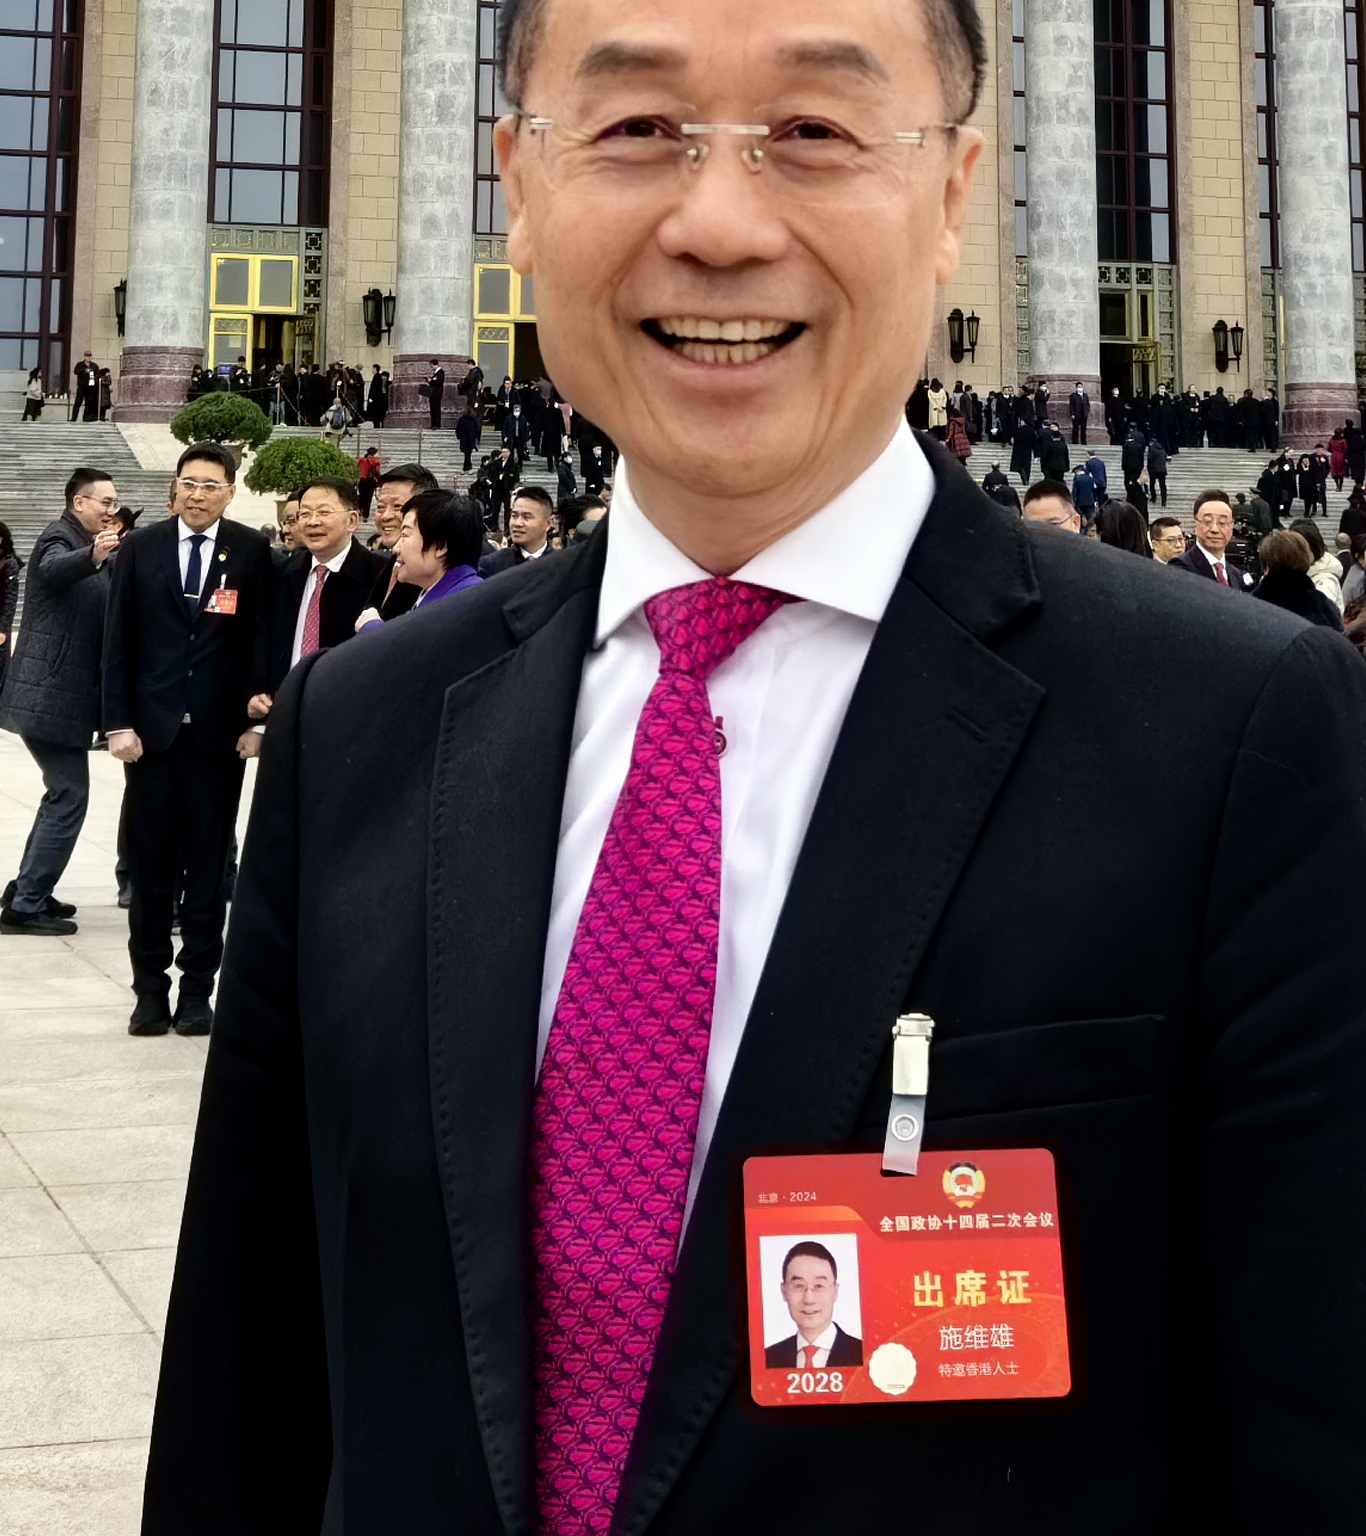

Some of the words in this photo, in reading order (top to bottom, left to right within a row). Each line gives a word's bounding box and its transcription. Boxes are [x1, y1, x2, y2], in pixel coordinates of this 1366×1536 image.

[790, 1191, 817, 1202] 2024
[880, 1212, 1054, 1232] 全国政协十四届二次会议
[914, 1269, 1032, 1308] 出席证
[939, 1323, 1015, 1351] 施维雄
[787, 1372, 843, 1394] 2028
